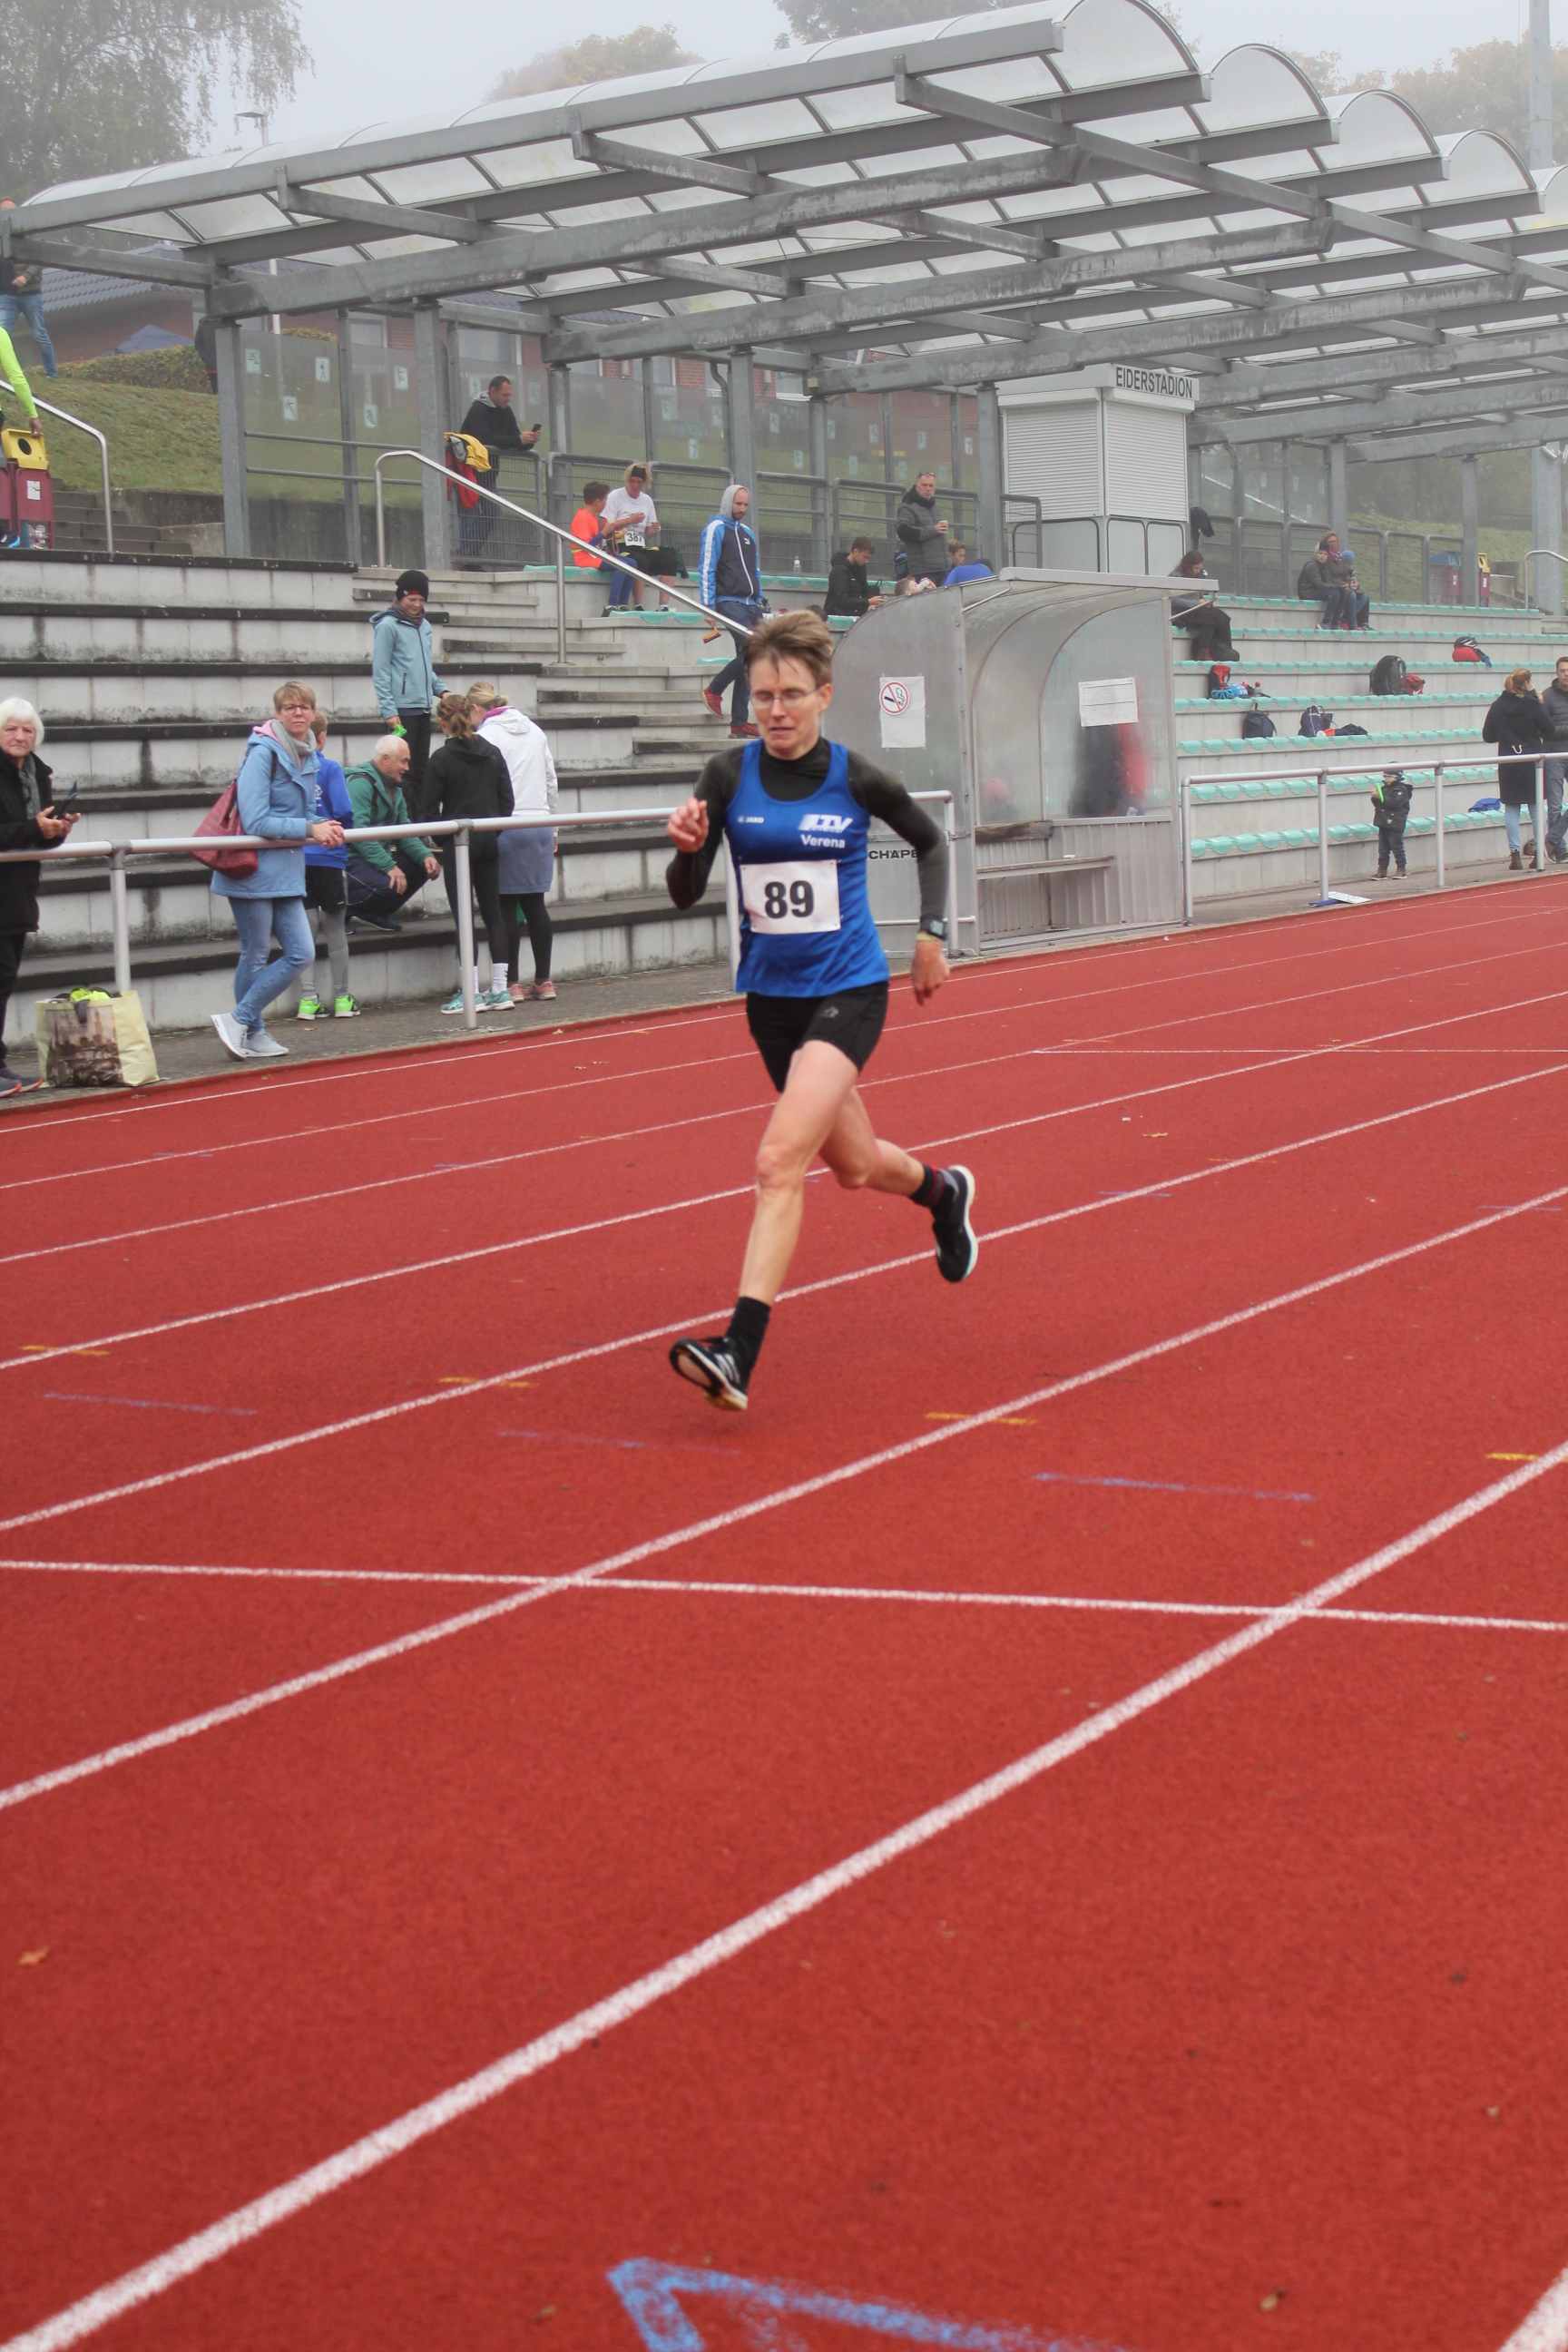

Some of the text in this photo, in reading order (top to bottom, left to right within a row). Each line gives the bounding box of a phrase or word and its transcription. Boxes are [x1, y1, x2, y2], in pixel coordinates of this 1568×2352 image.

[1115, 366, 1192, 398] EIDERSTADION
[800, 833, 847, 849] Verena
[764, 879, 815, 919] 89
